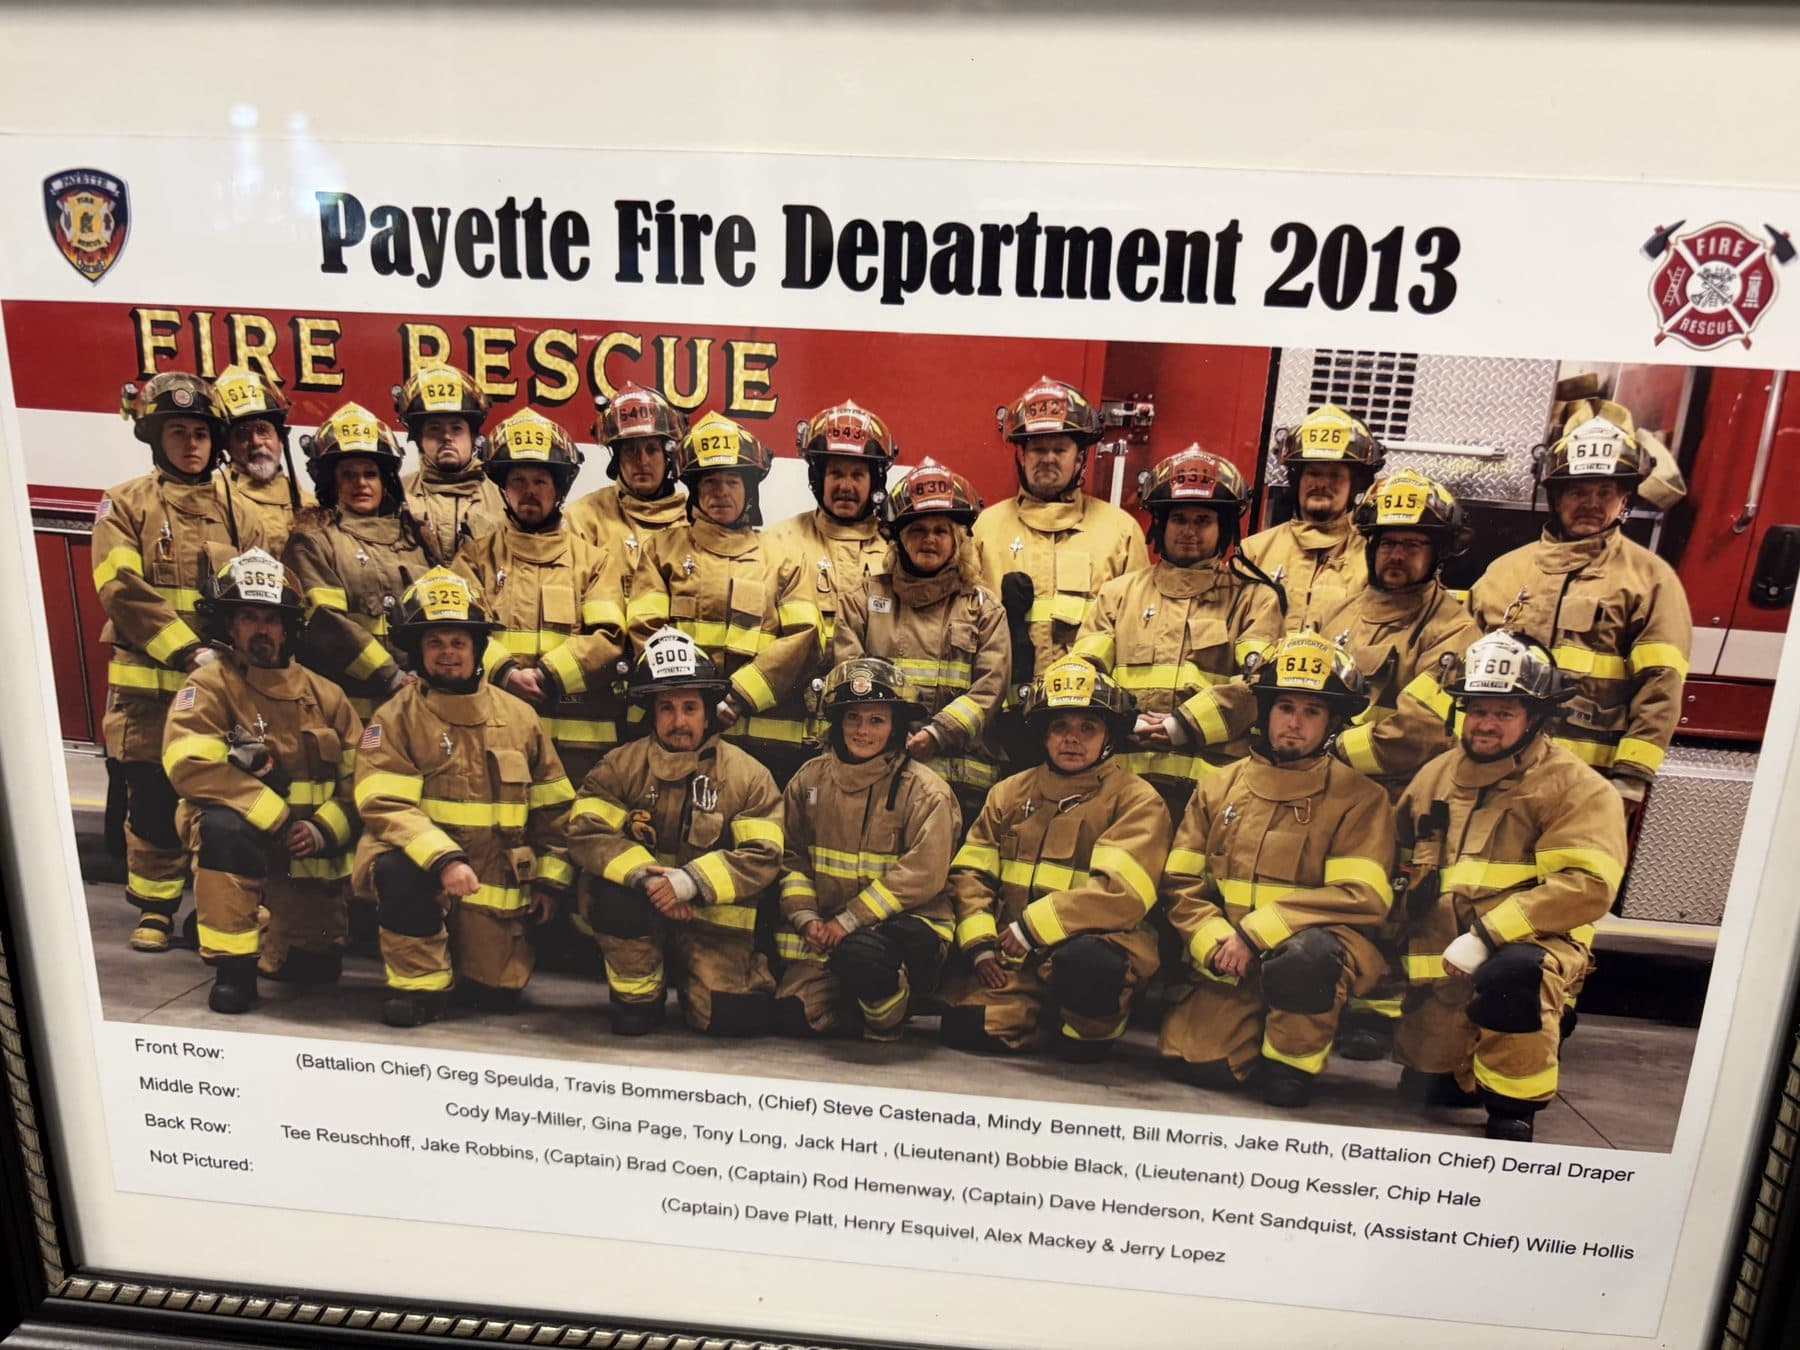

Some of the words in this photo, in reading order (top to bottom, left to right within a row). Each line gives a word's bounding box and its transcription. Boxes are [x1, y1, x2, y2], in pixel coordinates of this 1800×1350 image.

[316, 191, 591, 288] Payette
[615, 199, 757, 286] Fire
[781, 204, 1243, 307] Department
[1264, 221, 1461, 315] 2013
[1695, 236, 1745, 258] FIRE
[1679, 317, 1734, 336] RESCUE
[130, 307, 345, 392] FIRE
[400, 320, 779, 418] RESCUE
[228, 384, 258, 402] 612
[427, 383, 457, 399] 622
[1028, 400, 1058, 416] 642
[341, 423, 372, 438] 624
[513, 431, 544, 446] 619
[831, 427, 862, 440] 643
[1309, 428, 1342, 444] 626
[701, 435, 731, 451] 621
[1576, 442, 1613, 458] 610
[1384, 493, 1418, 509] 615
[429, 589, 462, 606] 625
[655, 648, 688, 665] 600
[1286, 656, 1322, 675] 613
[1053, 677, 1086, 692] 617
[134, 1037, 179, 1056] Front
[182, 1042, 225, 1060] Row:
[139, 1075, 194, 1095] Middle
[198, 1081, 241, 1099] Row:
[144, 1112, 186, 1130] Back
[189, 1116, 232, 1135] Row:
[295, 1053, 376, 1074] (Battalion
[380, 1060, 432, 1081] Chief)
[436, 1065, 479, 1086] Greg
[484, 1069, 559, 1092] Speulda,
[564, 1076, 617, 1096] Travis
[621, 1081, 752, 1109] Bommersbach,
[758, 1093, 818, 1116] (Chief)
[823, 1098, 874, 1118] Steve
[878, 1103, 981, 1129] Castenada,
[987, 1113, 1043, 1136] Mindy
[1050, 1119, 1126, 1141] Bennett,
[1132, 1125, 1161, 1142] Bill
[1165, 1128, 1228, 1150] Morris,
[1234, 1133, 1280, 1152] Jake
[1284, 1137, 1334, 1159] Ruth,
[1341, 1142, 1432, 1165] (Battalion
[1437, 1151, 1496, 1174] Chief)
[1501, 1156, 1563, 1177] Derral
[1567, 1162, 1636, 1184] Draper
[149, 1149, 179, 1165] Not
[182, 1152, 254, 1172] Pictured:
[445, 1101, 490, 1123] Cody
[494, 1106, 586, 1131] May-Miller,
[591, 1115, 632, 1133] Gina
[637, 1119, 687, 1140] Page,
[692, 1124, 734, 1145] Tony
[739, 1128, 787, 1150] Long,
[794, 1133, 835, 1151] Jack
[840, 1137, 879, 1155] Hart
[893, 1142, 1001, 1169] (Lieutenant)
[1005, 1151, 1069, 1172] Bobbie
[1073, 1157, 1128, 1179] Black,
[1135, 1162, 1245, 1189] (Lieutenant)
[1250, 1172, 1300, 1195] Doug
[1305, 1177, 1380, 1200] Kessler,
[1386, 1184, 1431, 1206] Chip
[1436, 1188, 1482, 1208] Hale
[279, 1124, 312, 1141] Tee
[315, 1127, 415, 1152] Reuschhoff,
[420, 1137, 461, 1154] Jake
[465, 1140, 539, 1163] Robbins,
[543, 1148, 622, 1172] (Captain)
[626, 1155, 667, 1173] Brad
[671, 1160, 723, 1181] Coen,
[728, 1164, 808, 1189] (Captain)
[812, 1172, 849, 1190] Rod
[854, 1176, 955, 1203] Hemenway,
[961, 1186, 1044, 1210] (Captain)
[1049, 1193, 1096, 1212] Dave
[1101, 1198, 1205, 1223] Henderson,
[1211, 1207, 1255, 1226] Kent
[1259, 1212, 1357, 1237] Sandquist,
[1363, 1221, 1458, 1245] (Assistant
[1462, 1231, 1520, 1254] Chief)
[1526, 1236, 1577, 1256] Willie
[1582, 1241, 1635, 1260] Hollis
[661, 1196, 740, 1221] (Captain)
[744, 1204, 790, 1223] Dave
[794, 1209, 838, 1229] Platt,
[843, 1214, 896, 1236] Henry
[901, 1219, 979, 1242] Esquivel,
[983, 1227, 1023, 1244] Alex
[1028, 1231, 1097, 1254] Mackey
[1101, 1238, 1115, 1253] &
[1119, 1240, 1166, 1261] Jerry
[1170, 1244, 1226, 1264] Lopez
